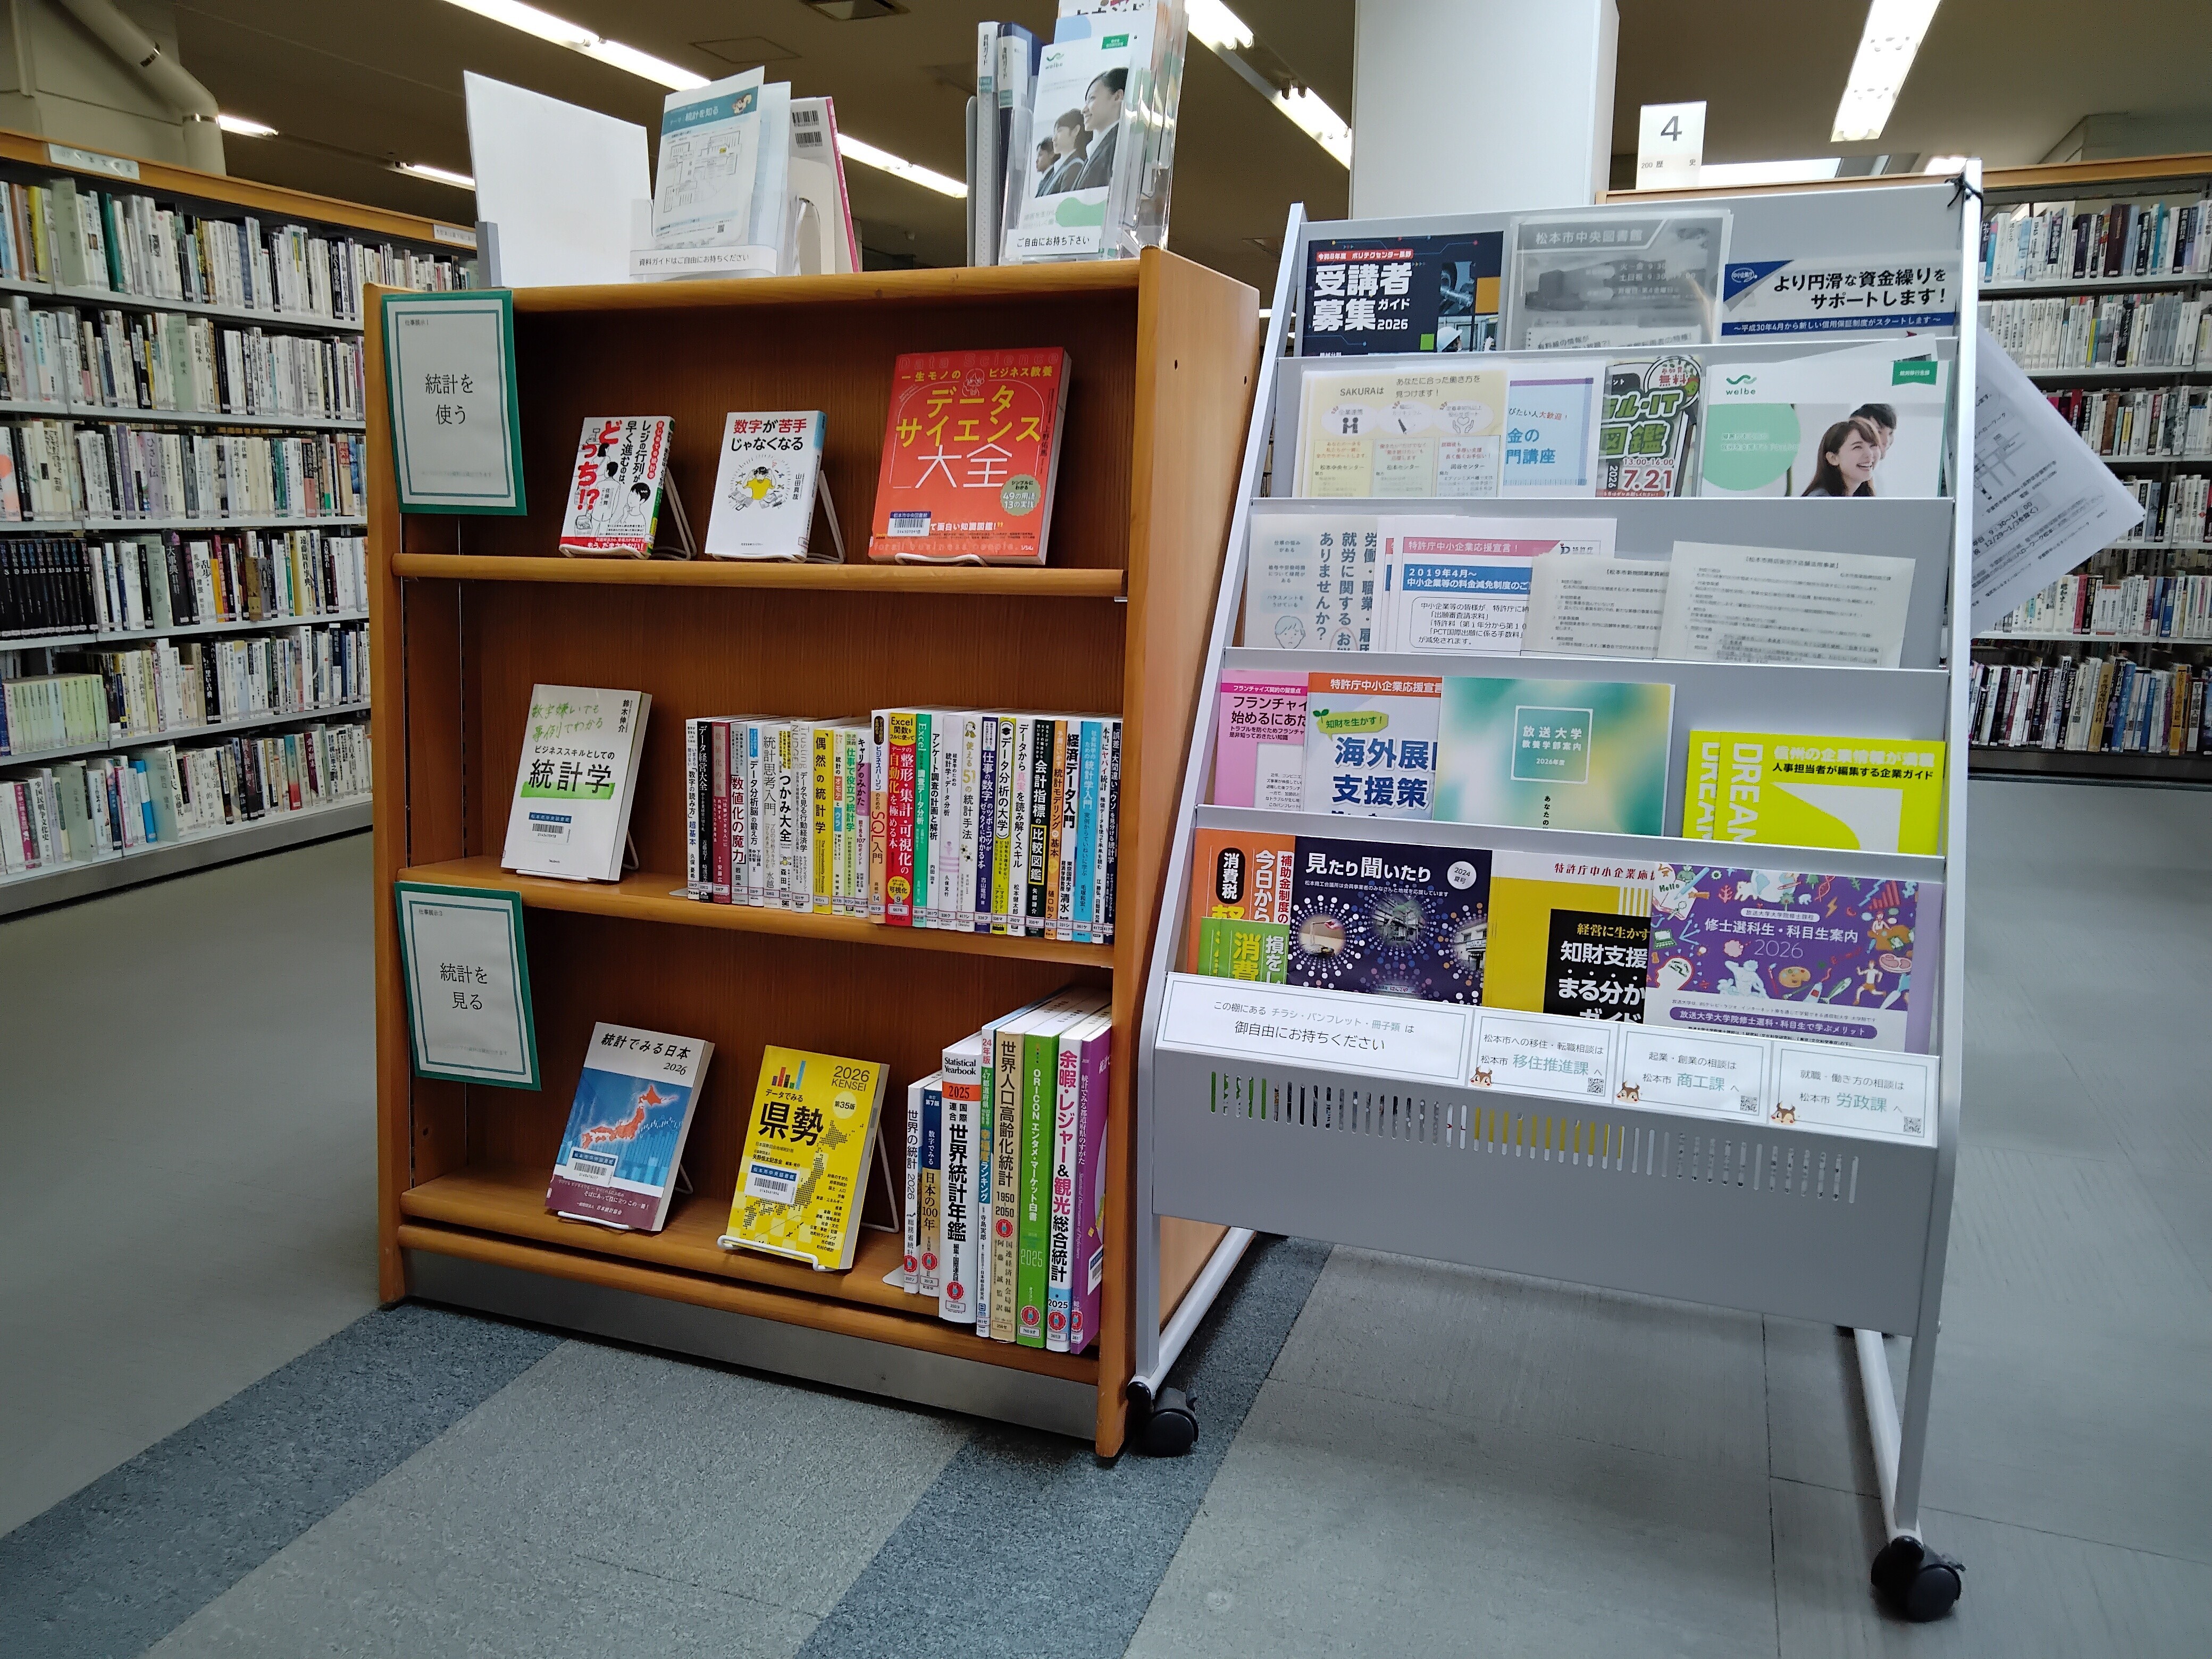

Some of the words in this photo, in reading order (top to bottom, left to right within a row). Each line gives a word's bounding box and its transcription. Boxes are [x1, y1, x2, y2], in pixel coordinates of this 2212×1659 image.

[1661, 115, 1682, 141] 4
[1016, 236, 1090, 248] ご自由にお持ち下さい
[1535, 229, 1643, 245] 松本市中央図書館
[639, 254, 749, 266] 資料ガイドはご自由にお持ちください
[1314, 262, 1413, 297] 受講者
[1774, 267, 1946, 291] より円滑な資金繰りを
[1811, 288, 1945, 309] サポートします!
[1313, 298, 1376, 332] 募集
[1378, 298, 1410, 311] ガイド
[1377, 319, 1408, 330] 2026
[425, 373, 473, 395] 統計を
[901, 370, 961, 382] 一生モノの
[989, 366, 1053, 377] ビジネス教養
[1396, 374, 1481, 386] あなたに合った働き方を
[927, 385, 1015, 418] データ
[1340, 387, 1384, 396] SAKURAは
[1396, 389, 1439, 398] 見つけます!
[1726, 387, 1756, 396] welbe
[435, 405, 466, 425] 使う
[733, 418, 807, 434] 数字が苦手
[731, 435, 804, 451] じゃなくなる
[896, 416, 1041, 447] サイエンス
[1508, 428, 1539, 444] 金の
[619, 421, 637, 484] 早く進むのは、
[633, 420, 651, 483] レジの行列が
[1505, 448, 1556, 465] 門講座
[915, 443, 1012, 488] 大全
[1608, 465, 1618, 488] 2026
[792, 473, 802, 500] 山田真哉
[1624, 470, 1673, 489] 7.21
[618, 700, 630, 733] 鈴木伸介
[1233, 697, 1306, 711] フランチャイ
[533, 717, 603, 742] 事例でわかる
[891, 717, 913, 726] Excel
[1231, 711, 1305, 726] 始めるにあた
[1522, 726, 1582, 740] 放送大学
[1522, 740, 1581, 751] 教養学部案内
[535, 745, 615, 760] ビジネススキルとしての
[699, 726, 707, 791] データ経営大全
[799, 726, 809, 769] Trusting
[1100, 727, 1110, 791] 本当にヤバイ統計
[1335, 736, 1437, 769] 海外展
[529, 759, 611, 793] 統計学
[764, 736, 776, 816] 統計思考入門
[857, 739, 866, 806] キャリアのみかた
[1063, 733, 1079, 828] 経済データ入門
[1773, 763, 1933, 780] 人事担当者が編集する企業ガイド
[847, 749, 856, 832] 仕事で役立つ統計学
[929, 734, 940, 840] アンケート調査の計画と解析
[962, 742, 976, 840] 使える51の統計手法
[1013, 725, 1029, 868] データから真実を読み解くスキル
[1033, 760, 1048, 824] 会計指標の
[1332, 774, 1428, 807] 支援策
[780, 775, 792, 842] つかみ大全
[889, 753, 900, 849] 自動化を極める本
[899, 753, 914, 874] 整形・集計・可視化の
[1050, 769, 1063, 857] 統計モデリングの基本
[731, 775, 746, 865] 「数値化の魔力」
[871, 811, 885, 864] SQL入門
[1030, 828, 1043, 881] 比較図鑑
[1222, 852, 1239, 900] 消費税
[1305, 853, 1431, 883] 見たり聞いたり
[1454, 867, 1471, 877] 2024
[1254, 850, 1275, 923] 今日から
[1278, 855, 1292, 923] 補助金制度の
[1659, 883, 1680, 892] Hello
[1577, 923, 1650, 941] 経営に生かす
[1705, 918, 1858, 943] 修士選科生・科目生案内
[1561, 941, 1648, 969] 知財支援
[1754, 940, 1804, 959] 2026
[440, 962, 488, 984] 統計を
[452, 991, 483, 1010] 見る
[1213, 1001, 1266, 1016] この棚にある
[1271, 1008, 1401, 1033] チラシ・パンフレット・冊子類
[1405, 1025, 1414, 1034] は
[1679, 1010, 1866, 1036] 放送大学大学院修士選科・科目生で学ぶメリット
[601, 1032, 691, 1060] 統計でみる日本
[1235, 1020, 1386, 1051] 御自由にお持ちください
[1484, 1034, 1604, 1055] 松本市への移住・転職相談は
[945, 1057, 976, 1067] Statistical
[983, 1038, 992, 1064] 24年版
[1649, 1052, 1737, 1070] 起業・創業の相談は
[663, 1062, 686, 1075] 2026
[834, 1066, 869, 1083] 2026
[944, 1065, 976, 1075] Yearbook
[1480, 1055, 1508, 1066] 松本市
[1513, 1054, 1589, 1076] 移住推進課
[831, 1079, 867, 1092] KENSEI
[949, 1086, 969, 1099] 2025
[1643, 1073, 1672, 1084] 松本市
[1677, 1072, 1724, 1092] 商工課
[1800, 1070, 1904, 1091] 就職・働き方の相談は
[766, 1089, 803, 1103] データでみる
[834, 1101, 856, 1110] 第35版
[1032, 1069, 1041, 1120] ORICON
[1799, 1092, 1830, 1104] 松本市
[1837, 1092, 1887, 1112] 労政課
[758, 1101, 824, 1146] 県勢
[949, 1102, 957, 1122] 連合
[959, 1103, 968, 1122] 国際
[998, 1041, 1016, 1187] 世界人口高齢化統計
[1078, 1075, 1088, 1164] 統計でみる都道府県のすがた
[907, 1110, 918, 1169] 世界の統計
[752, 1154, 782, 1165] 矢野恒太記念会
[980, 1129, 991, 1202] 幸福度ランキング
[1051, 1050, 1078, 1283] 余暇・レジャー&観光総合統計
[948, 1123, 968, 1242] 世界統計年鑑
[1029, 1125, 1040, 1222] エンタメ・マーケット白書
[923, 1172, 937, 1230] 日本の100年
[996, 1192, 1015, 1203] 1950
[995, 1206, 1014, 1217] 2050
[1021, 1249, 1043, 1267] 2025
[1004, 1241, 1013, 1313] 国連経済社会局編
[1048, 1298, 1068, 1309] 2025
